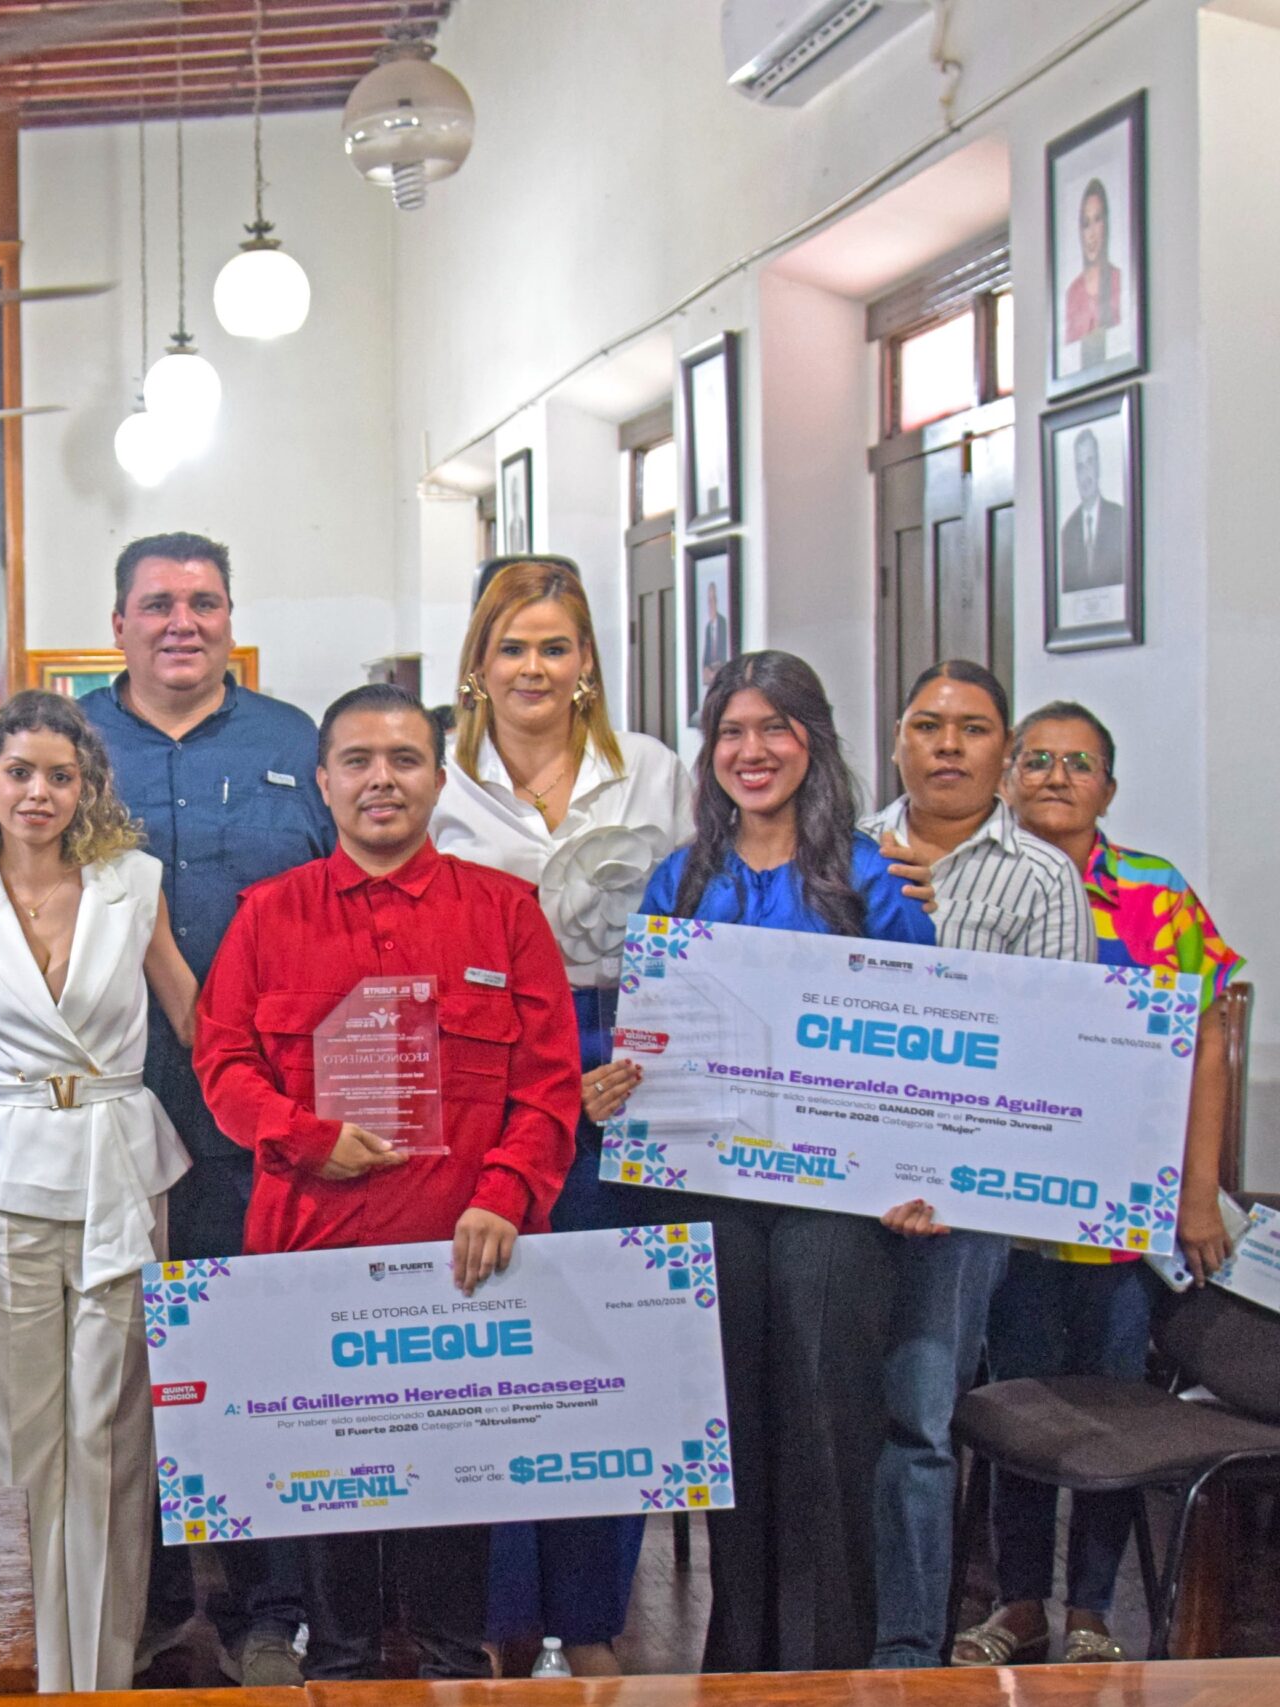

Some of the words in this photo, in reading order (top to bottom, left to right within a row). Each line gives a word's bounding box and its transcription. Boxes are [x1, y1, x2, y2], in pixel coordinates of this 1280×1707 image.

[879, 959, 912, 969] FUERTE
[802, 992, 820, 1004] SE
[822, 995, 840, 1006] LE
[842, 996, 899, 1012] OTORGA
[902, 1003, 919, 1015] EL
[922, 1006, 998, 1024] PRESENTE:
[796, 1013, 999, 1069] CHEQUE
[706, 1061, 784, 1080] Yesenia
[789, 1069, 898, 1094] Esmeralda
[903, 1083, 990, 1106] Campos
[994, 1094, 1082, 1117] Aguilera
[728, 1084, 748, 1094] Por
[749, 1087, 779, 1098] haber
[782, 1092, 805, 1101] sido
[806, 1095, 876, 1110] seleccionado
[878, 1103, 934, 1117] GANADOR
[936, 1111, 950, 1119] en
[952, 1113, 962, 1121] el
[964, 1113, 1007, 1126] Premio
[1009, 1119, 1052, 1132] Juvenil
[795, 1105, 806, 1113] El
[807, 1106, 847, 1118] Fuerte
[849, 1111, 879, 1122] 2026
[732, 1136, 772, 1149] PREMIO
[791, 1142, 836, 1157] MÉRITO
[718, 1146, 847, 1180] JUVENIL
[894, 1162, 918, 1171] con
[920, 1166, 936, 1174] un
[737, 1168, 752, 1177] EL
[754, 1170, 793, 1182] FUERTE
[894, 1172, 923, 1182] valor
[925, 1175, 943, 1185] de:
[949, 1164, 1098, 1210] $2,500
[400, 1261, 433, 1270] FUERTE
[330, 1312, 348, 1323] SE
[351, 1309, 368, 1320] LE
[371, 1305, 428, 1319] OTORGA
[431, 1304, 448, 1314] EL
[451, 1297, 527, 1312] PRESENTE:
[331, 1318, 533, 1367] CHEQUE
[163, 1385, 195, 1394] QUINTA
[246, 1396, 287, 1414] Isaí
[292, 1392, 399, 1410] Guillermo
[404, 1382, 492, 1402] Heredia
[497, 1376, 625, 1393] Bacasegua
[276, 1420, 295, 1428] Por
[297, 1418, 327, 1427] haber
[330, 1416, 353, 1425] sido
[355, 1411, 424, 1423] seleccionado
[426, 1406, 482, 1417] GANADOR
[484, 1406, 497, 1414] en
[500, 1404, 510, 1413] el
[511, 1401, 553, 1411] Premio
[555, 1398, 598, 1409] Juvenil
[334, 1428, 345, 1436] El
[347, 1426, 386, 1435] Fuerte
[388, 1423, 418, 1432] 2026
[290, 1470, 330, 1480] PREMIO
[349, 1463, 395, 1476] MÉRITO
[453, 1465, 476, 1474] con
[478, 1463, 494, 1472] un
[508, 1447, 653, 1484] $2,500
[454, 1473, 483, 1483] valor
[486, 1472, 504, 1481] de:
[278, 1476, 408, 1504] JUVENIL
[301, 1502, 315, 1512] EL
[318, 1500, 357, 1511] FUERTE
